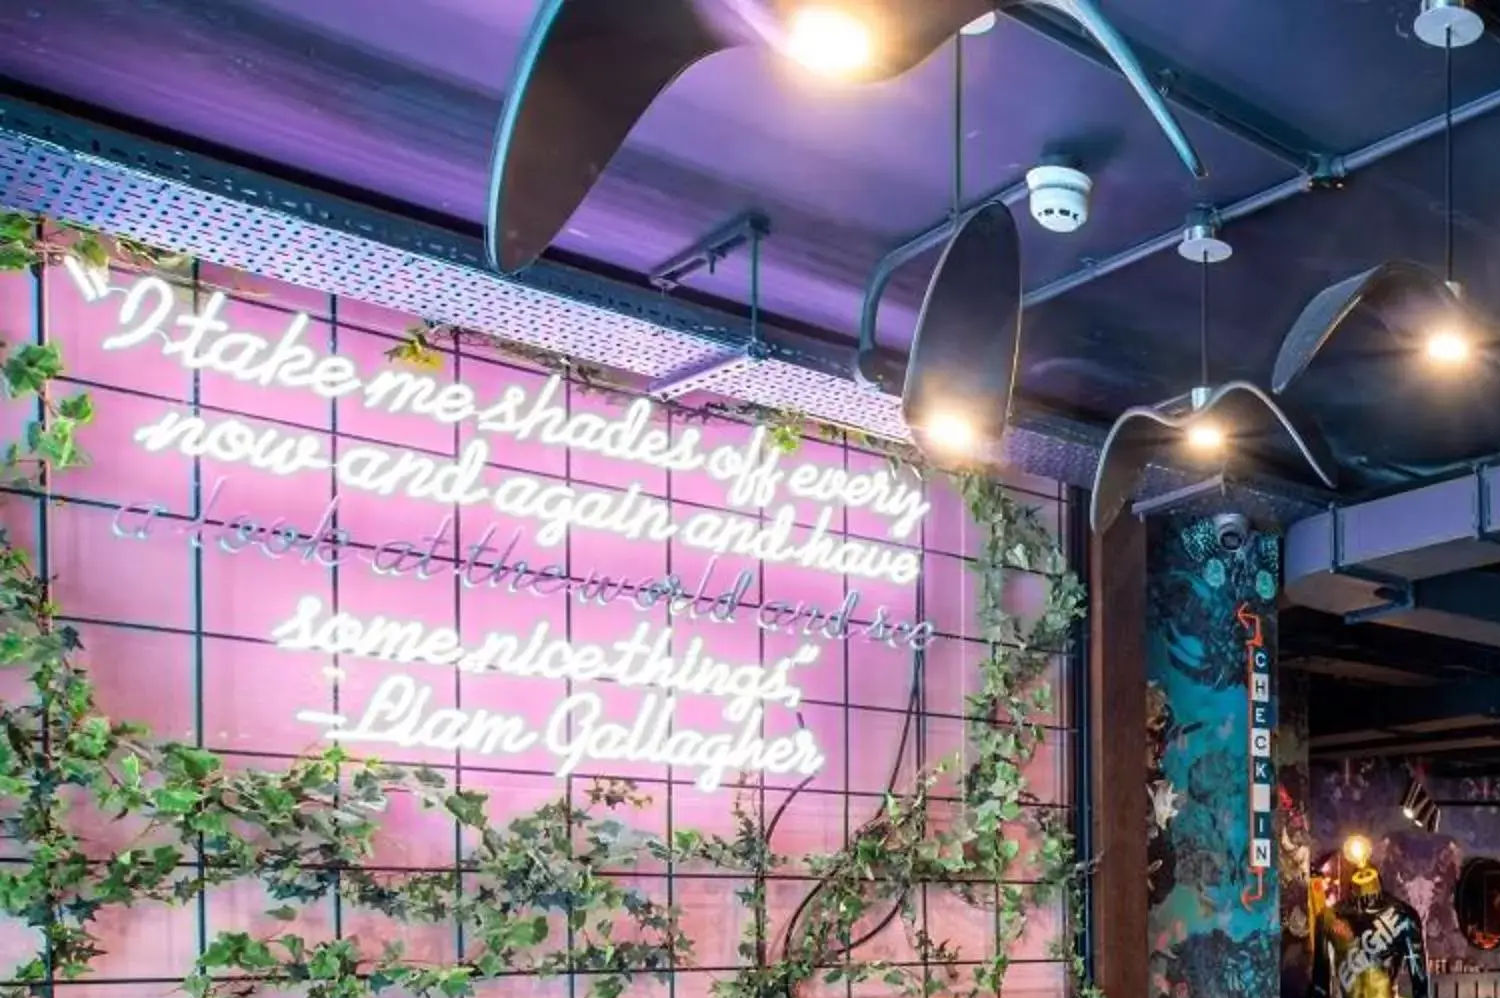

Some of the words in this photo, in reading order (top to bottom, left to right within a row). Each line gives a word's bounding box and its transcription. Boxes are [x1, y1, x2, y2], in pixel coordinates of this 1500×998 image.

[161, 290, 363, 398] take
[364, 370, 477, 423] me
[475, 374, 705, 470] shades
[705, 424, 784, 508] off
[788, 463, 932, 538] every
[134, 412, 332, 475] now
[336, 438, 490, 503] and
[493, 476, 677, 546] again
[683, 504, 798, 562] and
[796, 505, 922, 584] have
[112, 500, 168, 540] a
[173, 476, 358, 567] look
[371, 513, 458, 580] at
[461, 522, 570, 597] the
[577, 554, 754, 625] world
[756, 590, 860, 640] and
[864, 604, 938, 652] see
[271, 596, 464, 667] some
[458, 620, 606, 680] nice
[546, 690, 827, 793] Gallagher
[1254, 652, 1268, 779] CHECK
[1256, 816, 1269, 861] IN
